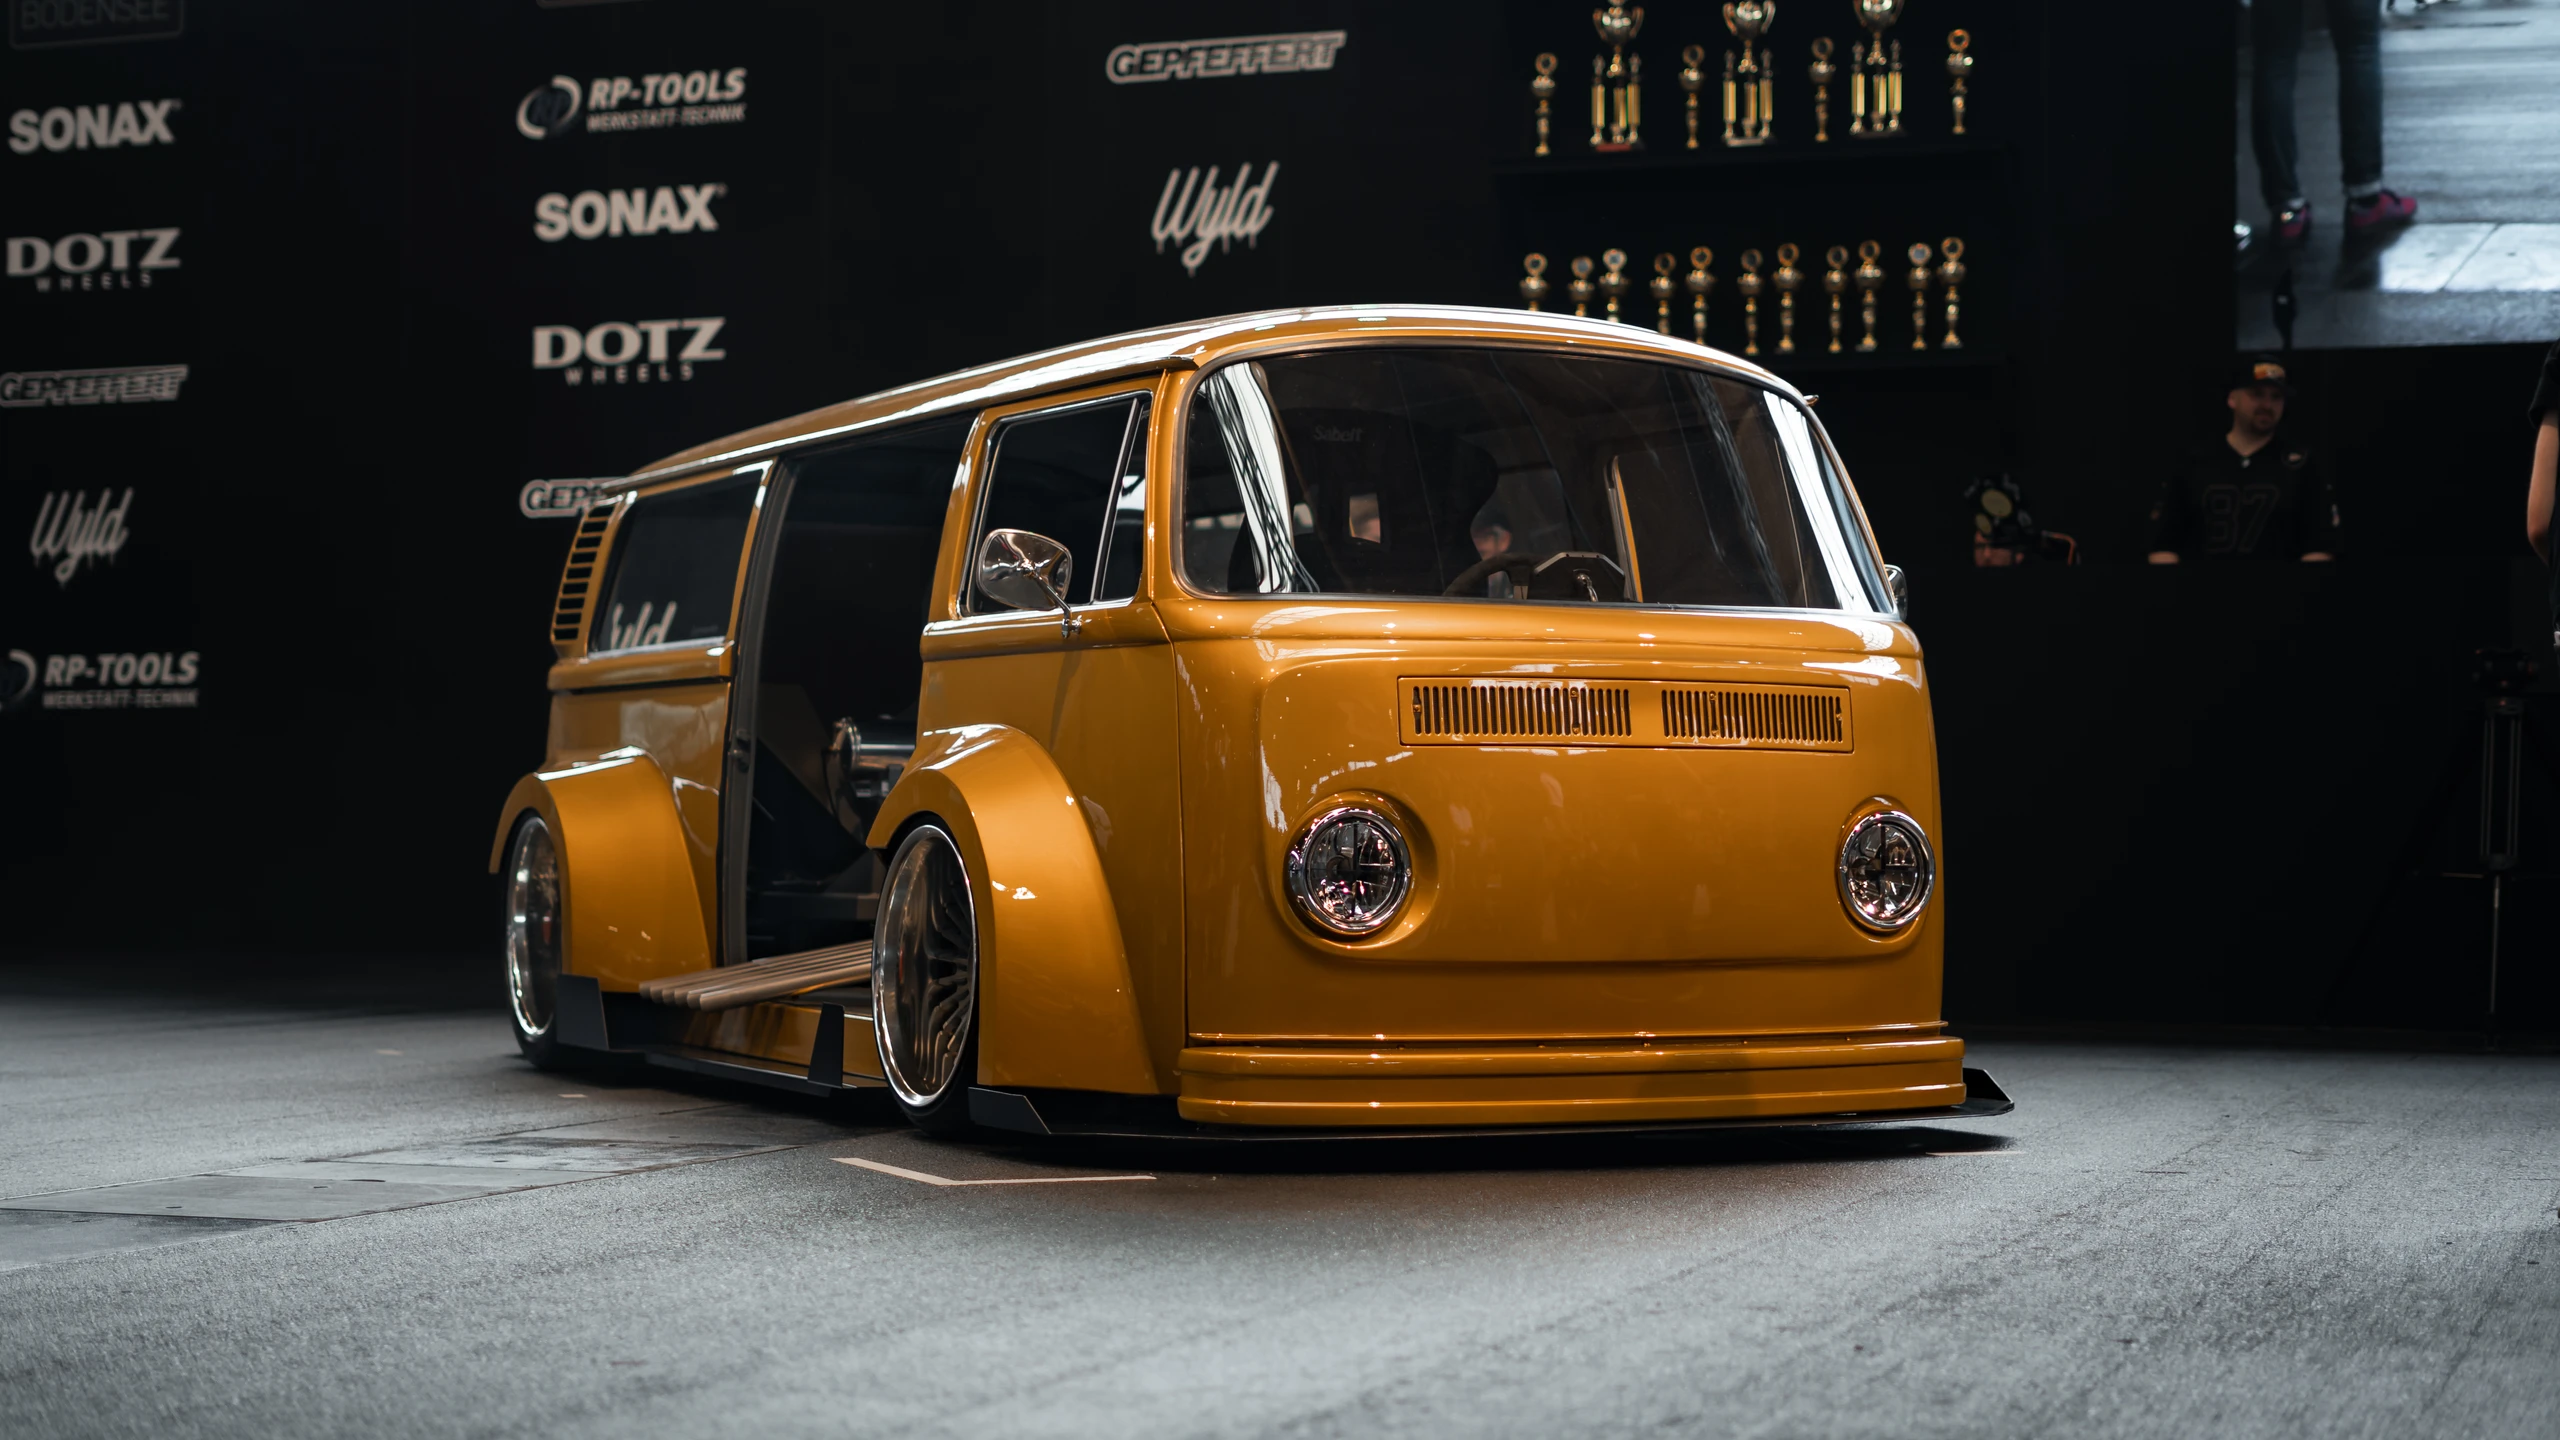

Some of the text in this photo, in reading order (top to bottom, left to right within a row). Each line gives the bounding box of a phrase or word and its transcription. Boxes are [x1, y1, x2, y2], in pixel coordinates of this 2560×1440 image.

[588, 67, 747, 111] RP-TOOLS
[9, 100, 174, 154] SONAX
[534, 184, 719, 242] SONAX
[1151, 161, 1279, 277] Wyld
[6, 227, 181, 277] DOTZ
[36, 271, 152, 291] WHEELS
[532, 316, 726, 368] DOTZ
[565, 363, 694, 385] WHEELS
[30, 487, 133, 587] Wyld
[44, 652, 200, 687] RP-TOOLS
